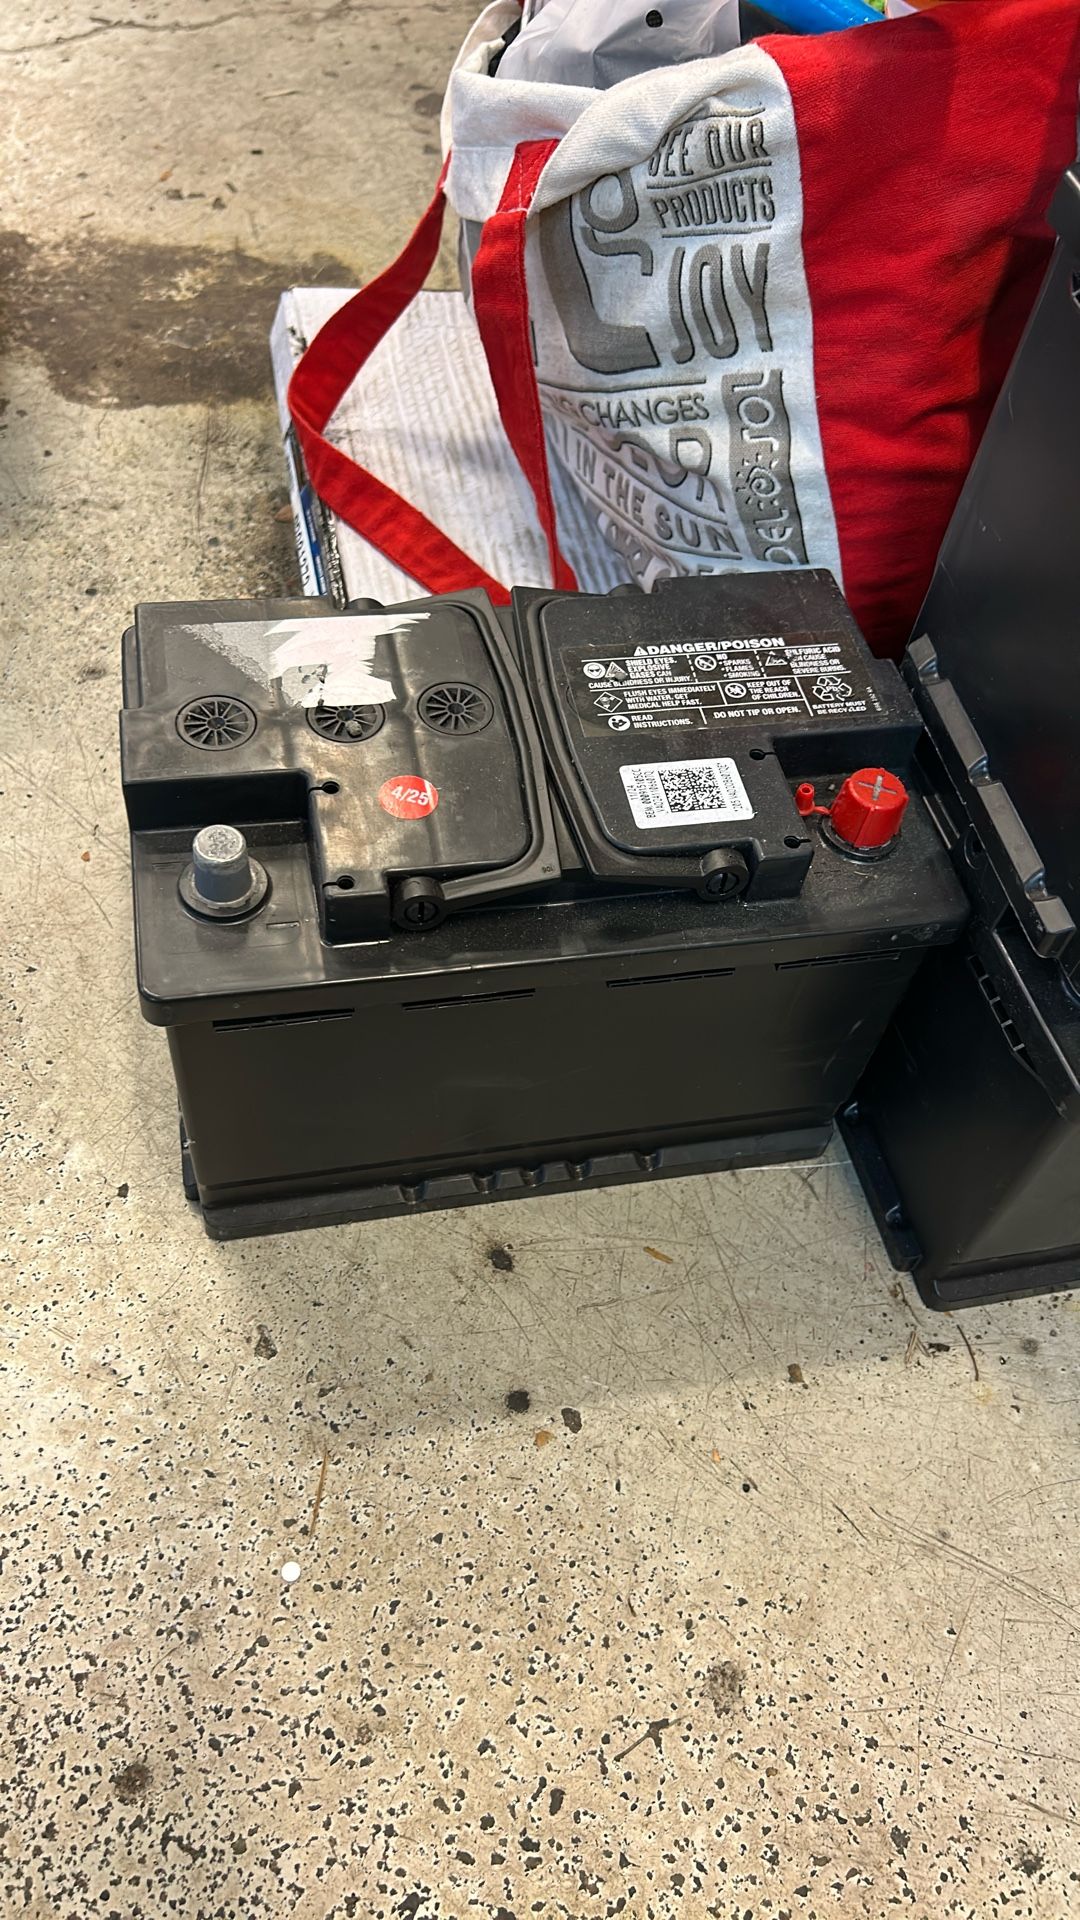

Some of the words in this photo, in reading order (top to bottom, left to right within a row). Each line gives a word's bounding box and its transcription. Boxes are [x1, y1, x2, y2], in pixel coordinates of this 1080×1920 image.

[705, 117, 770, 169] OUR
[650, 174, 775, 228] PRODUCTS
[668, 242, 774, 364] JOY
[579, 392, 710, 429] CHANGES
[576, 438, 596, 484] IN
[603, 461, 646, 526] THE
[654, 503, 740, 553] SUN
[647, 638, 785, 655] DANGER/POISON
[822, 646, 841, 654] ACID
[625, 657, 655, 667] SHIELD
[715, 653, 728, 661] NO
[627, 664, 671, 673] EXPLOSIVE
[790, 659, 829, 668] BLINDNESS
[630, 671, 656, 679] GASES
[588, 681, 613, 689] CAUSE
[623, 690, 647, 698] FLUSH
[648, 688, 667, 696] EYES
[668, 685, 716, 694] IMMEDIATELY
[625, 696, 645, 704] WITH
[628, 702, 661, 710] MEDICAL
[662, 700, 680, 708] HELP
[812, 701, 844, 710] BATTERY
[713, 711, 727, 719] DO
[728, 710, 746, 718] NOT
[761, 707, 775, 715] OR
[775, 706, 802, 714] OPEN.
[631, 714, 653, 722] READ
[633, 718, 693, 728] INSTRUCTIONS.
[391, 785, 429, 806] 4/25
